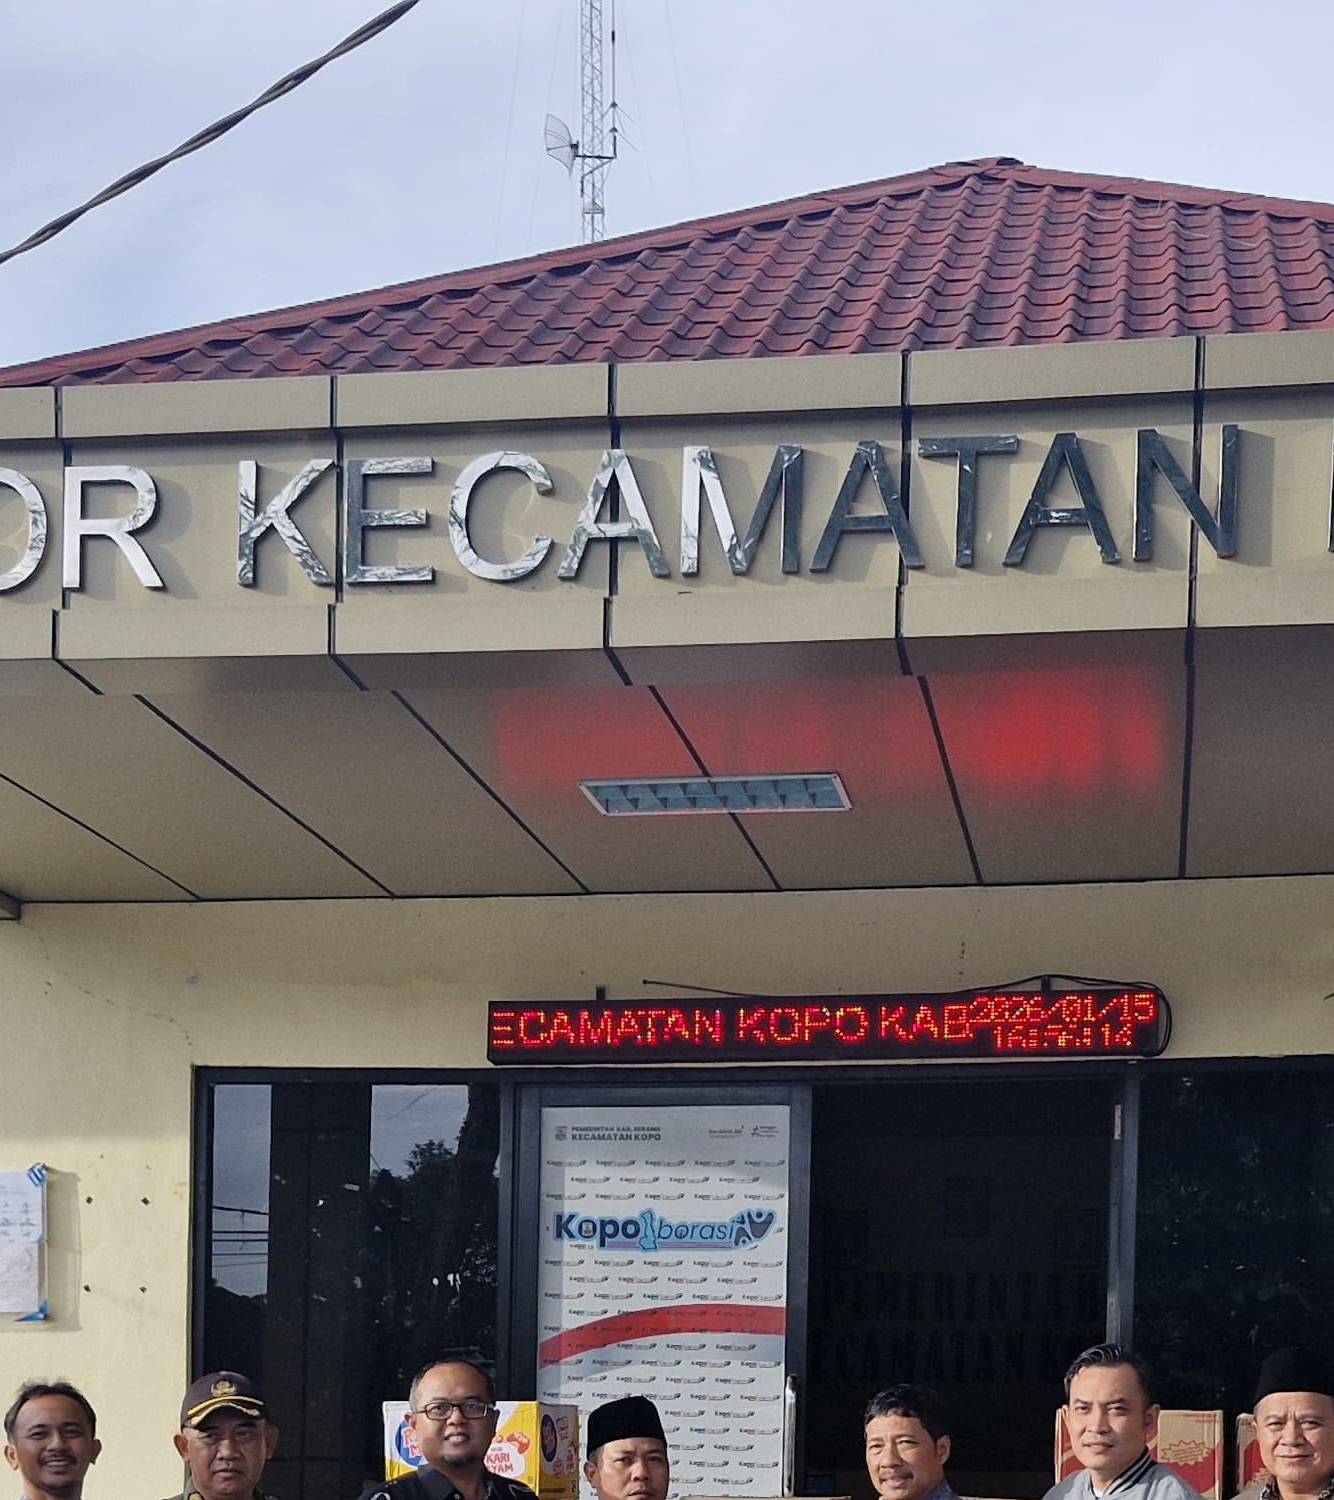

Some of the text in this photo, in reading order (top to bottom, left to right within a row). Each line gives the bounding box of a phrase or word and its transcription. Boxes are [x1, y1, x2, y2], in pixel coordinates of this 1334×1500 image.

[236, 423, 1241, 588] KECAMATAN
[737, 1005, 869, 1043] KOPO
[571, 1133, 661, 1141] KECAMATAN KOPO
[486, 1453, 510, 1465] KARI
